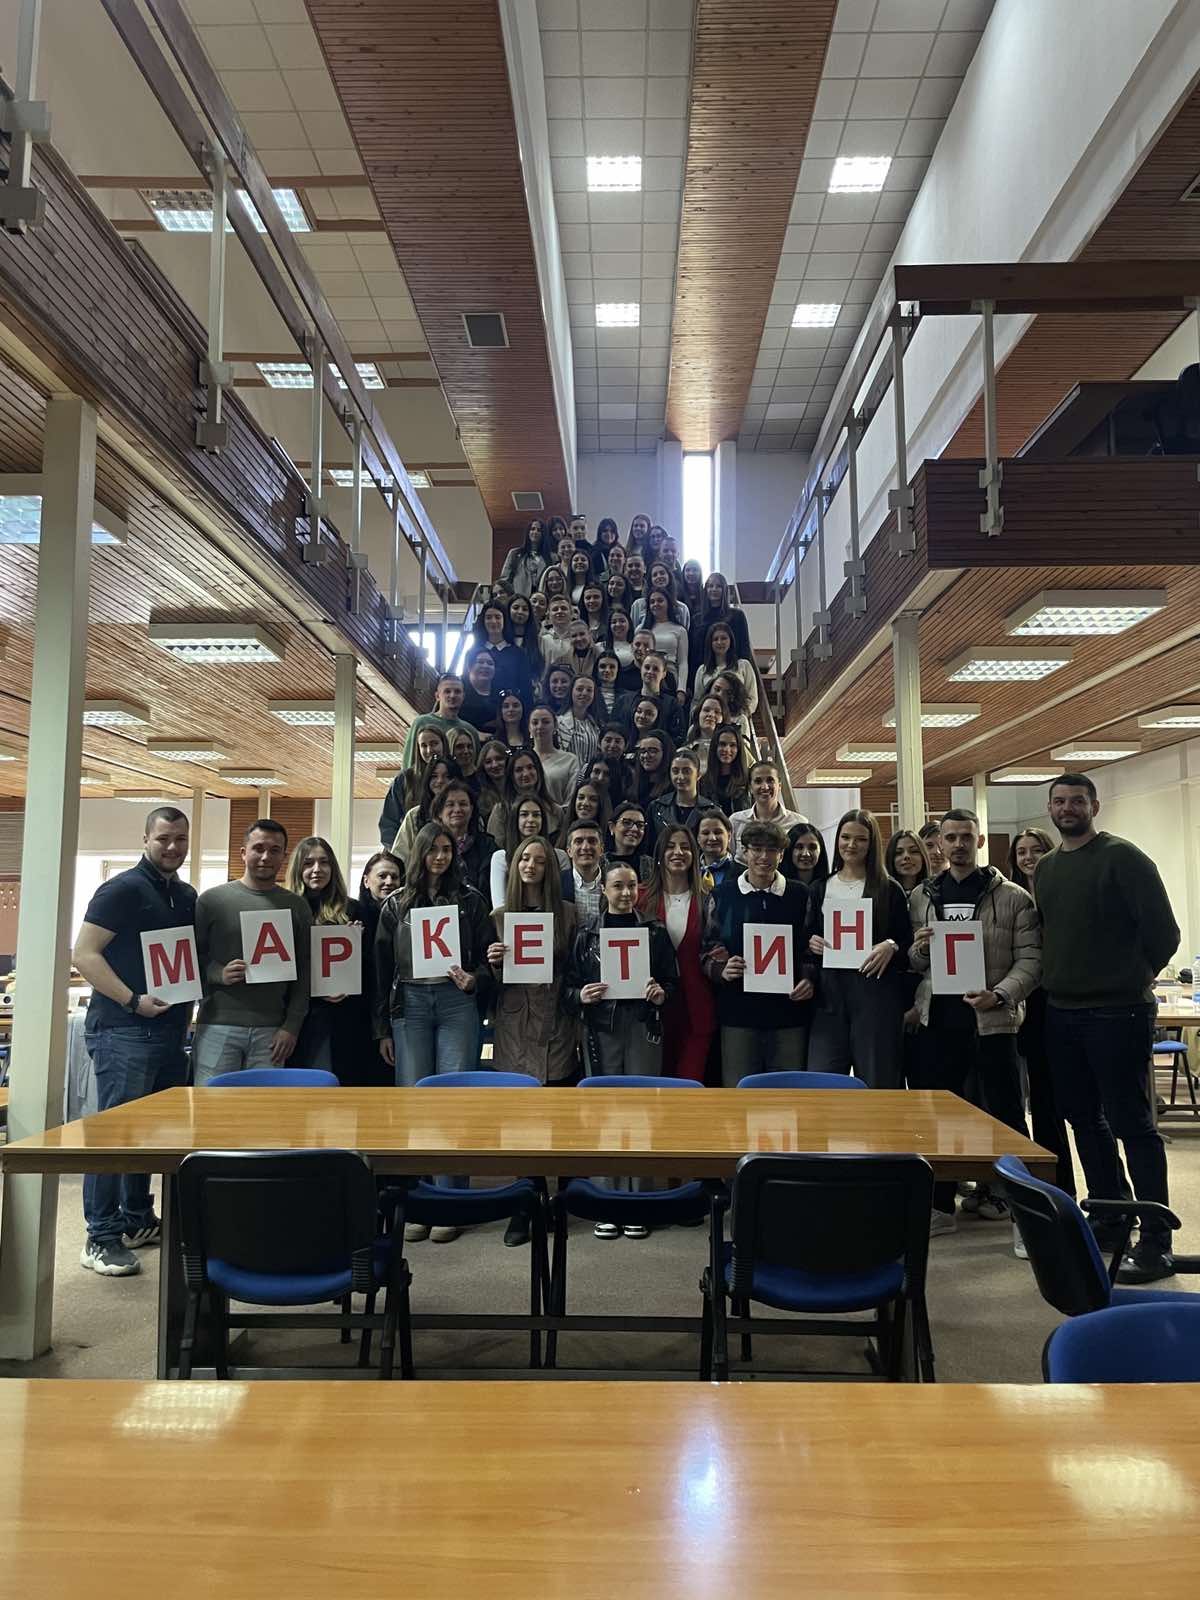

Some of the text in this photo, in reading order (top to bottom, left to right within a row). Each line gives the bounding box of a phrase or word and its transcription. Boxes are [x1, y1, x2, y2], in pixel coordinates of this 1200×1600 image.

[253, 923, 289, 964] А
[422, 916, 452, 959] К
[515, 925, 544, 965] Е
[833, 911, 864, 950] Н
[150, 940, 193, 986] М
[322, 938, 352, 976] Р
[608, 941, 640, 980] Т
[754, 935, 785, 976] И
[945, 934, 975, 975] Г
